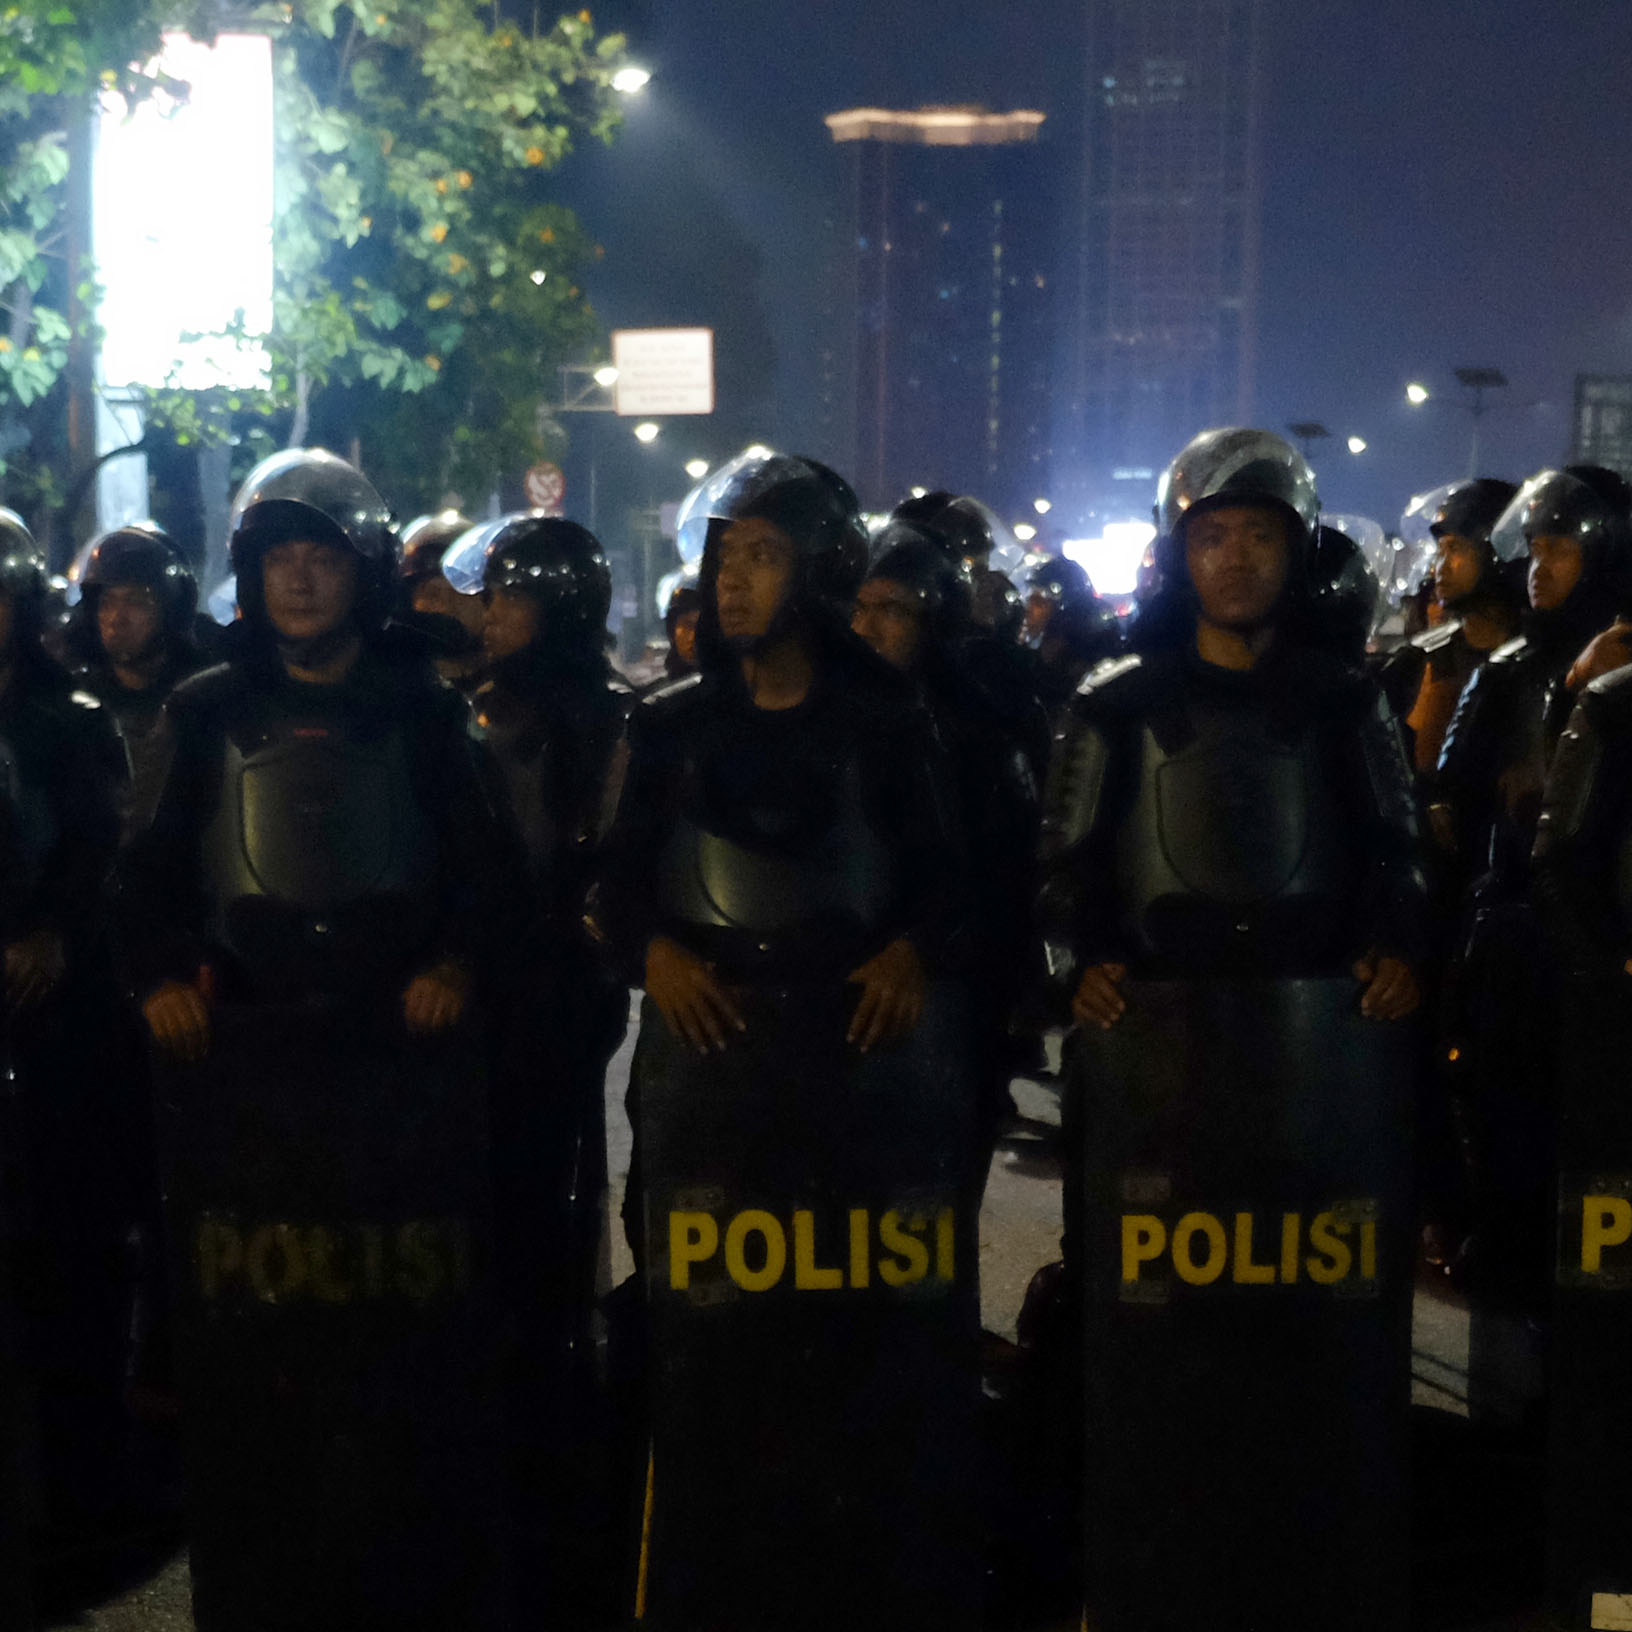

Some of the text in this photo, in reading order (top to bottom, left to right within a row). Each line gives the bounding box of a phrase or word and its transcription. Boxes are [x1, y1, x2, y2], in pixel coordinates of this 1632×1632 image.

[193, 1218, 471, 1304] POLISI
[668, 1209, 954, 1292] POLISI
[1121, 1209, 1376, 1286] POLISI
